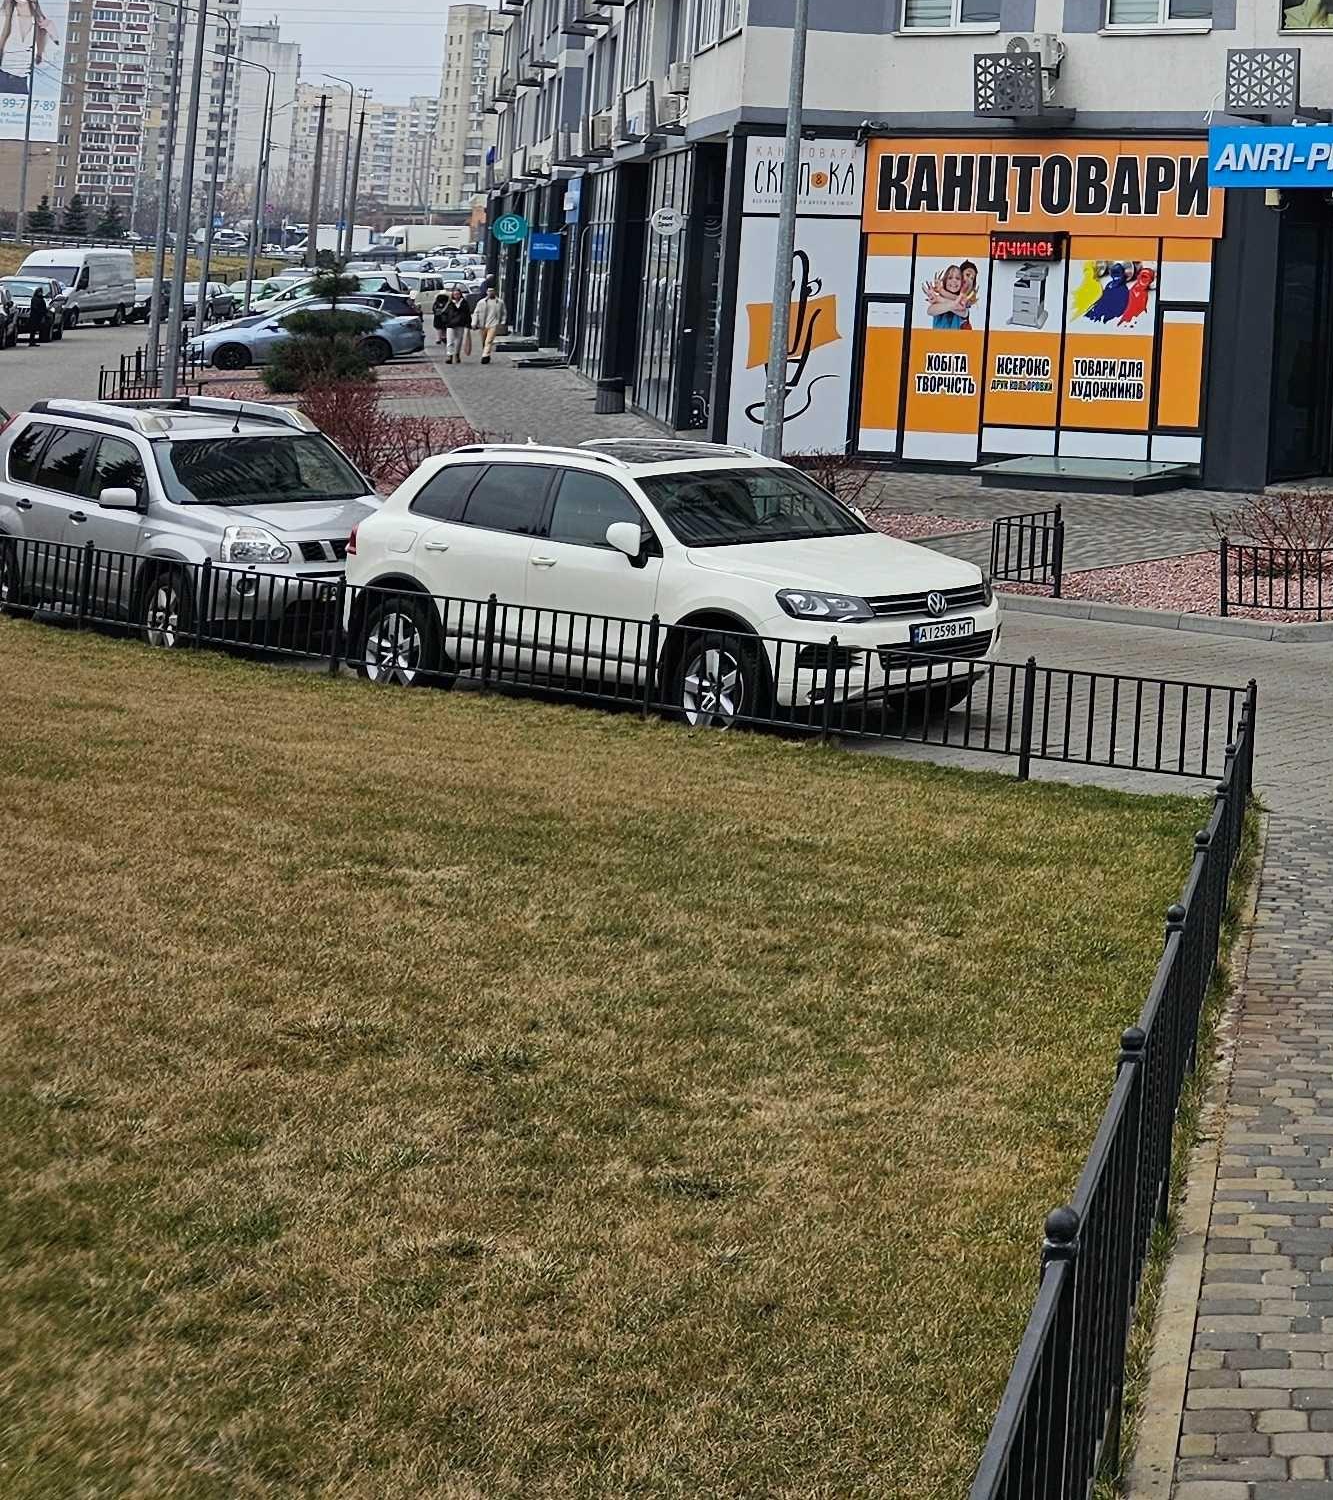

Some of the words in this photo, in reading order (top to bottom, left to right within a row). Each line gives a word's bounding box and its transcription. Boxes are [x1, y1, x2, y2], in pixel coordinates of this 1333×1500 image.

[755, 146, 857, 159] КАНТОВАРИ
[877, 154, 1209, 223] КАНЦТОВАРИ
[926, 353, 952, 373] ХОБІ
[953, 354, 968, 374] ТА
[996, 355, 1051, 377] КСЕРОКС
[1074, 358, 1116, 378] ТОВАРИ
[1117, 360, 1144, 381] ДЛЯ
[916, 375, 976, 395] ТВОРЧІСТЬ
[1069, 380, 1144, 401] ХУДОЖНИКІВ
[934, 623, 957, 639] 2598
[958, 621, 972, 635] MT
